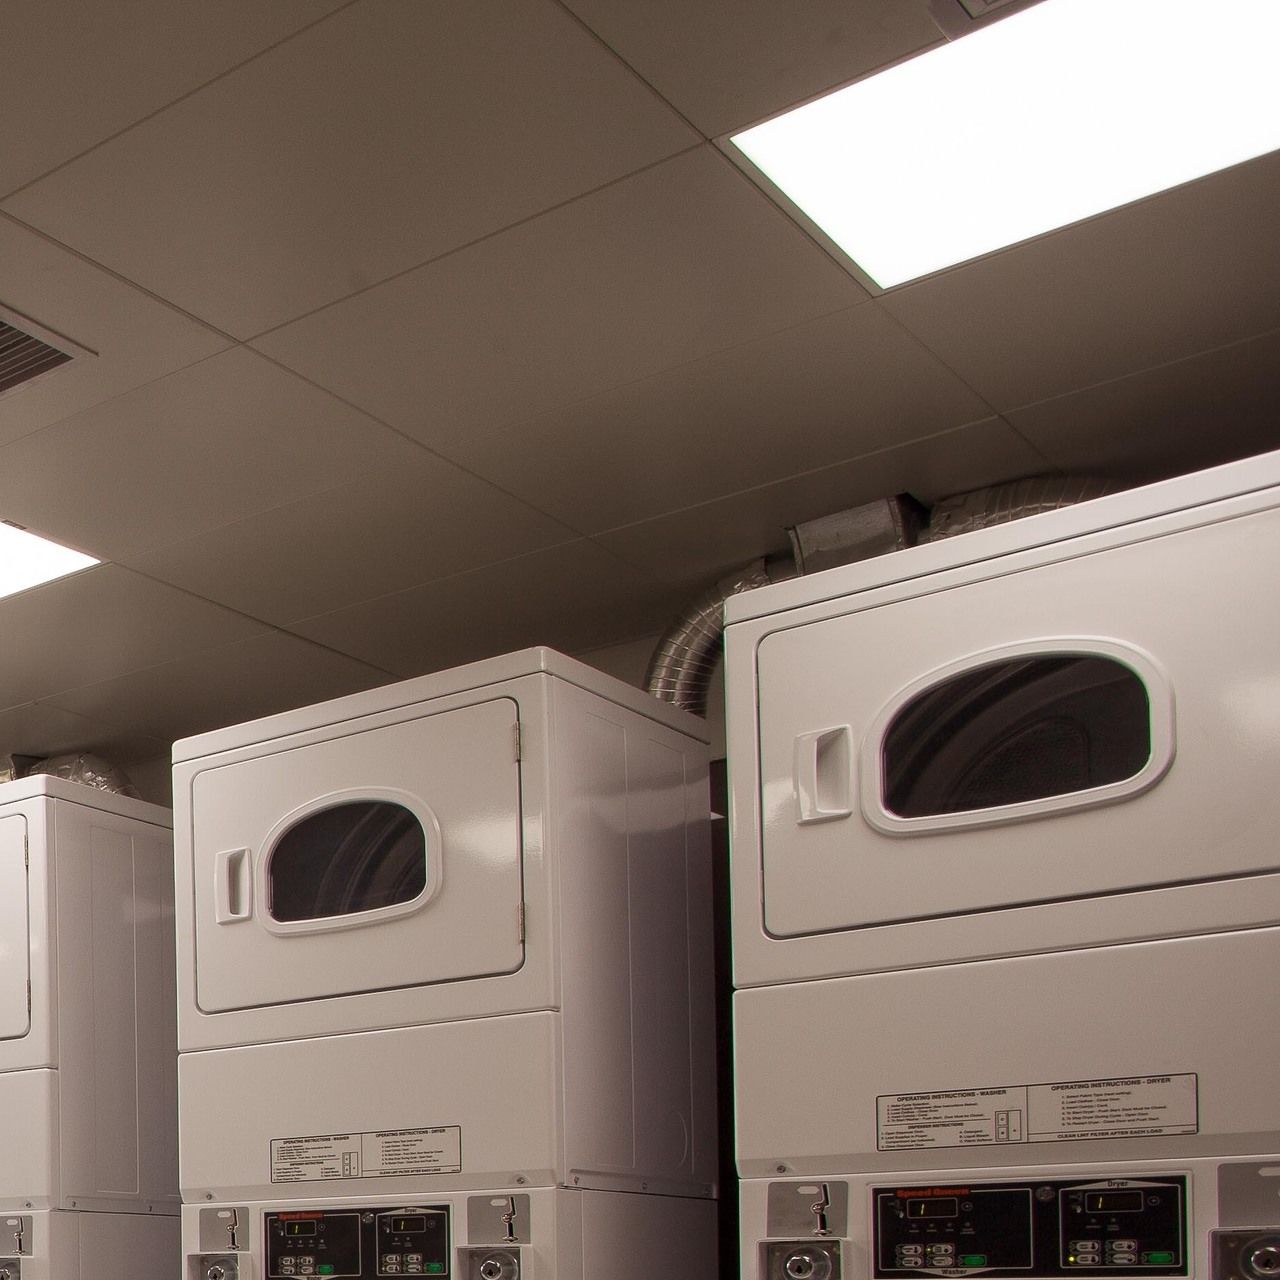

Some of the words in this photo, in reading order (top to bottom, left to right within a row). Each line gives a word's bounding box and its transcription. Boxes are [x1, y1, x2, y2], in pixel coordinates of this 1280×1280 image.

[1051, 1083, 1090, 1091] OPERATING
[1091, 1080, 1141, 1089] INSTRUCTIONS
[1146, 1077, 1172, 1085] DRYER
[932, 1092, 975, 1100] INSTRUCTIONS
[1107, 1180, 1129, 1188] Dryer
[896, 1188, 932, 1198] Speed
